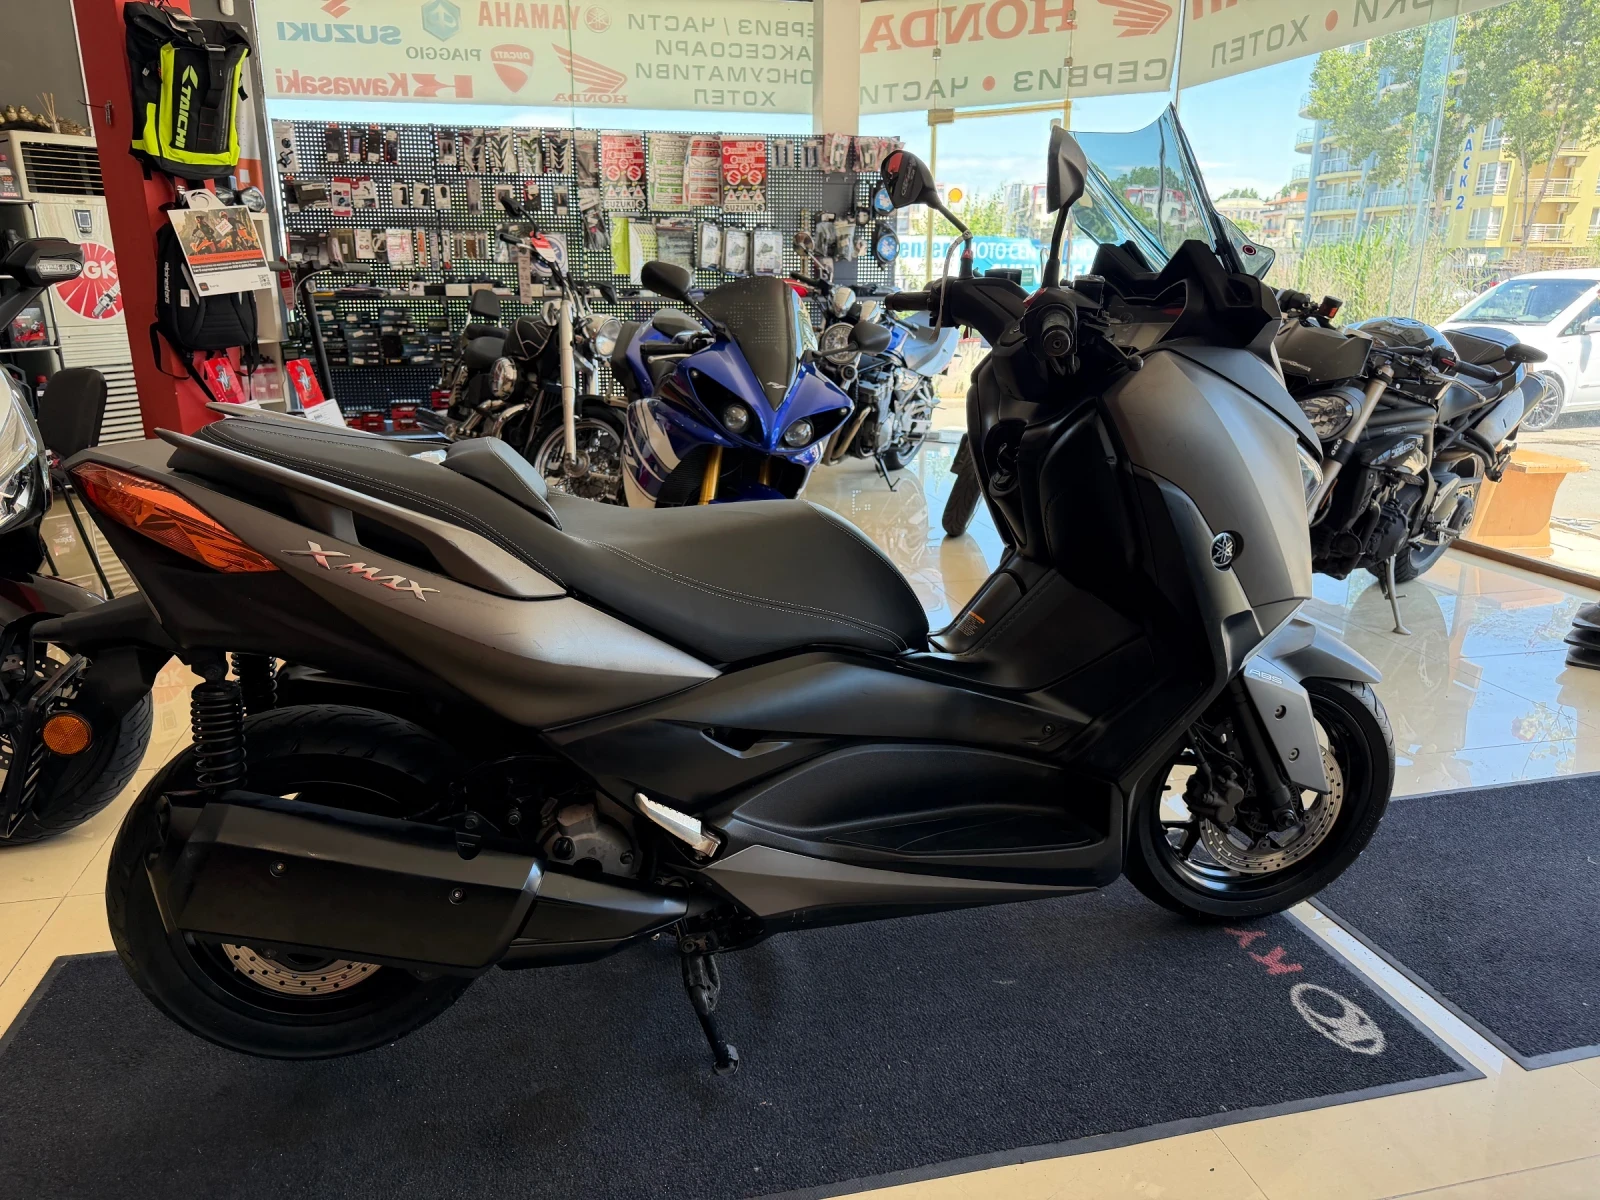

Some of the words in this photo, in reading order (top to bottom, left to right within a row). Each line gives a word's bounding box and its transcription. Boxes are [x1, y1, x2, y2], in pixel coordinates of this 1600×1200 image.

[174, 86, 192, 149] TAICHI
[605, 201, 635, 209] SUZUKI
[725, 203, 754, 212] SUZUKI
[79, 260, 117, 279] GK
[1249, 668, 1283, 685] ABS
